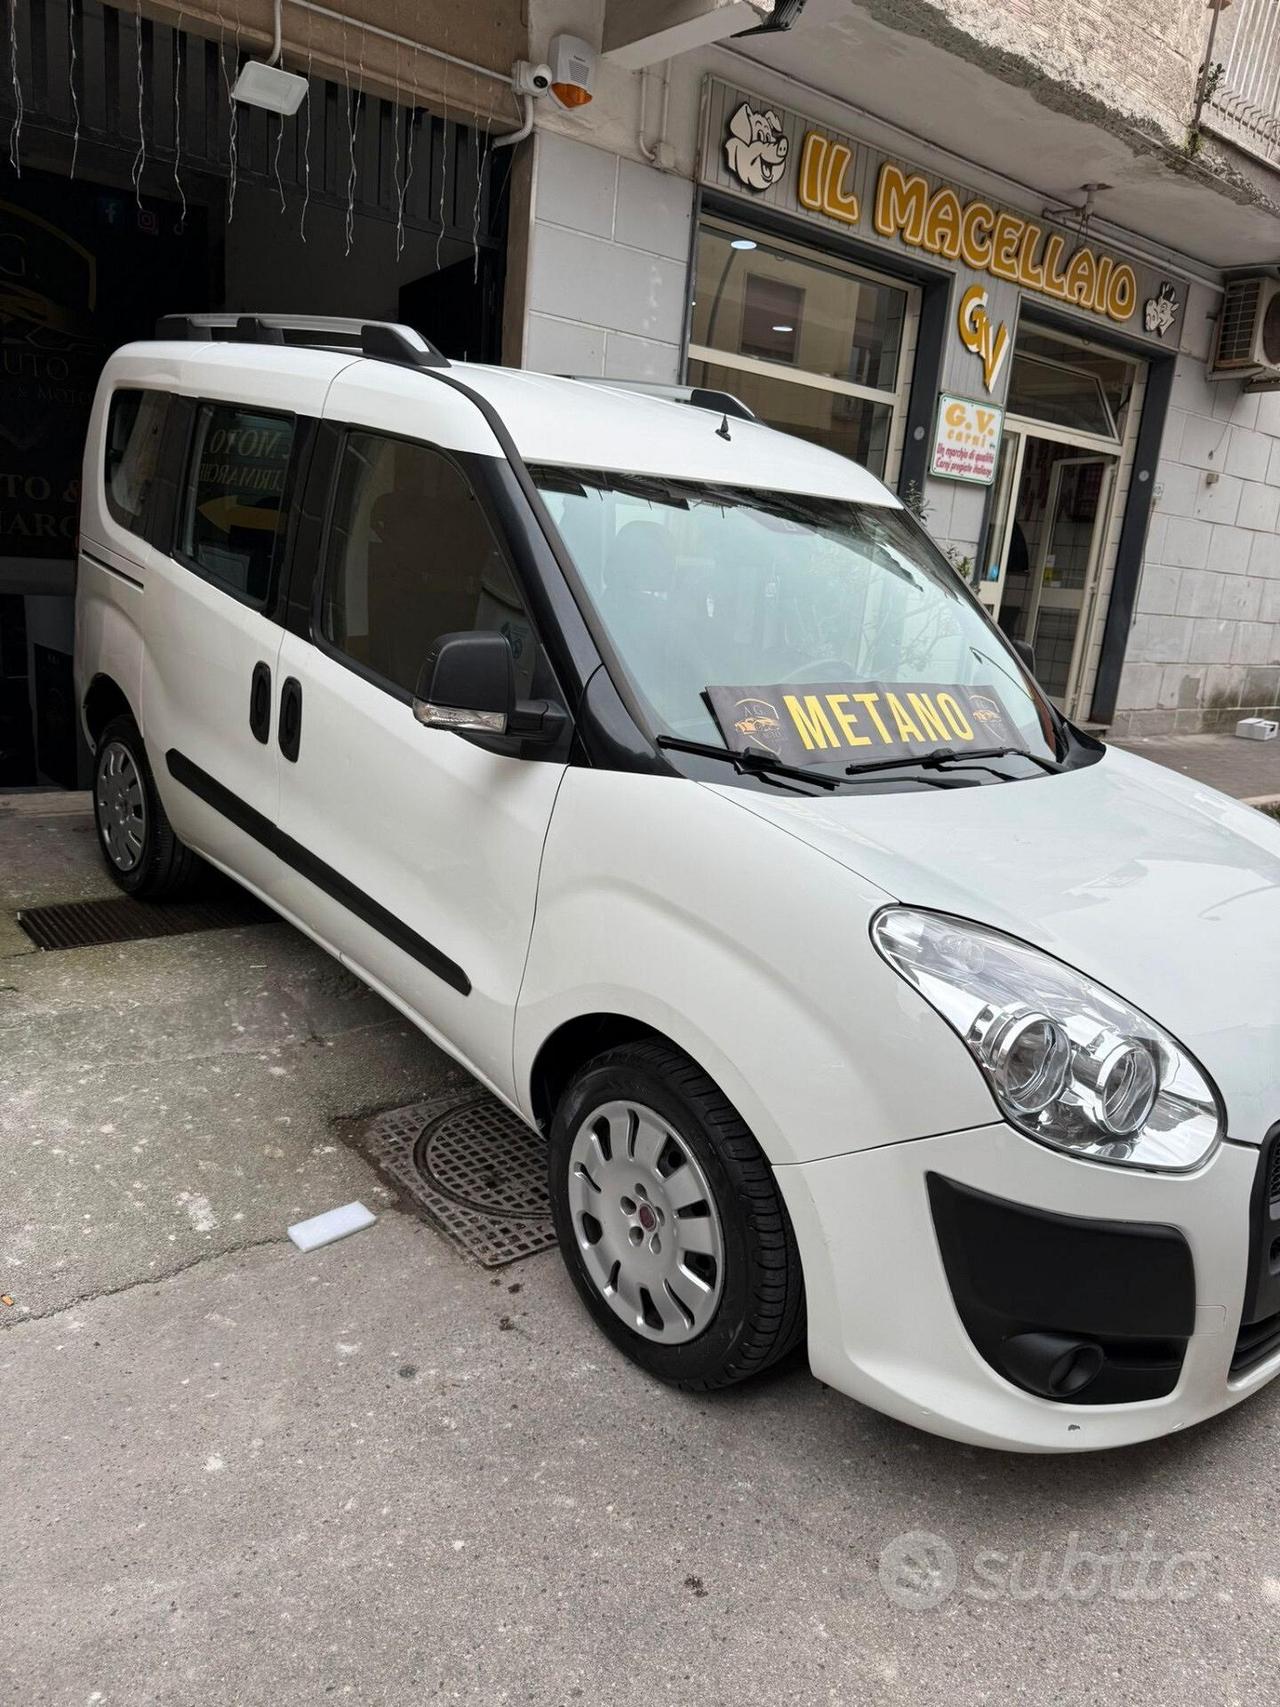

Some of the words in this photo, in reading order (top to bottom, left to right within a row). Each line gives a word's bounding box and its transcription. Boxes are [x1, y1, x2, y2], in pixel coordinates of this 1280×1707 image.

[800, 131, 860, 224] IL
[875, 161, 1139, 322] MACELLAIO
[945, 447, 968, 460] marchio
[947, 429, 987, 447] carni
[783, 692, 976, 750] METANO
